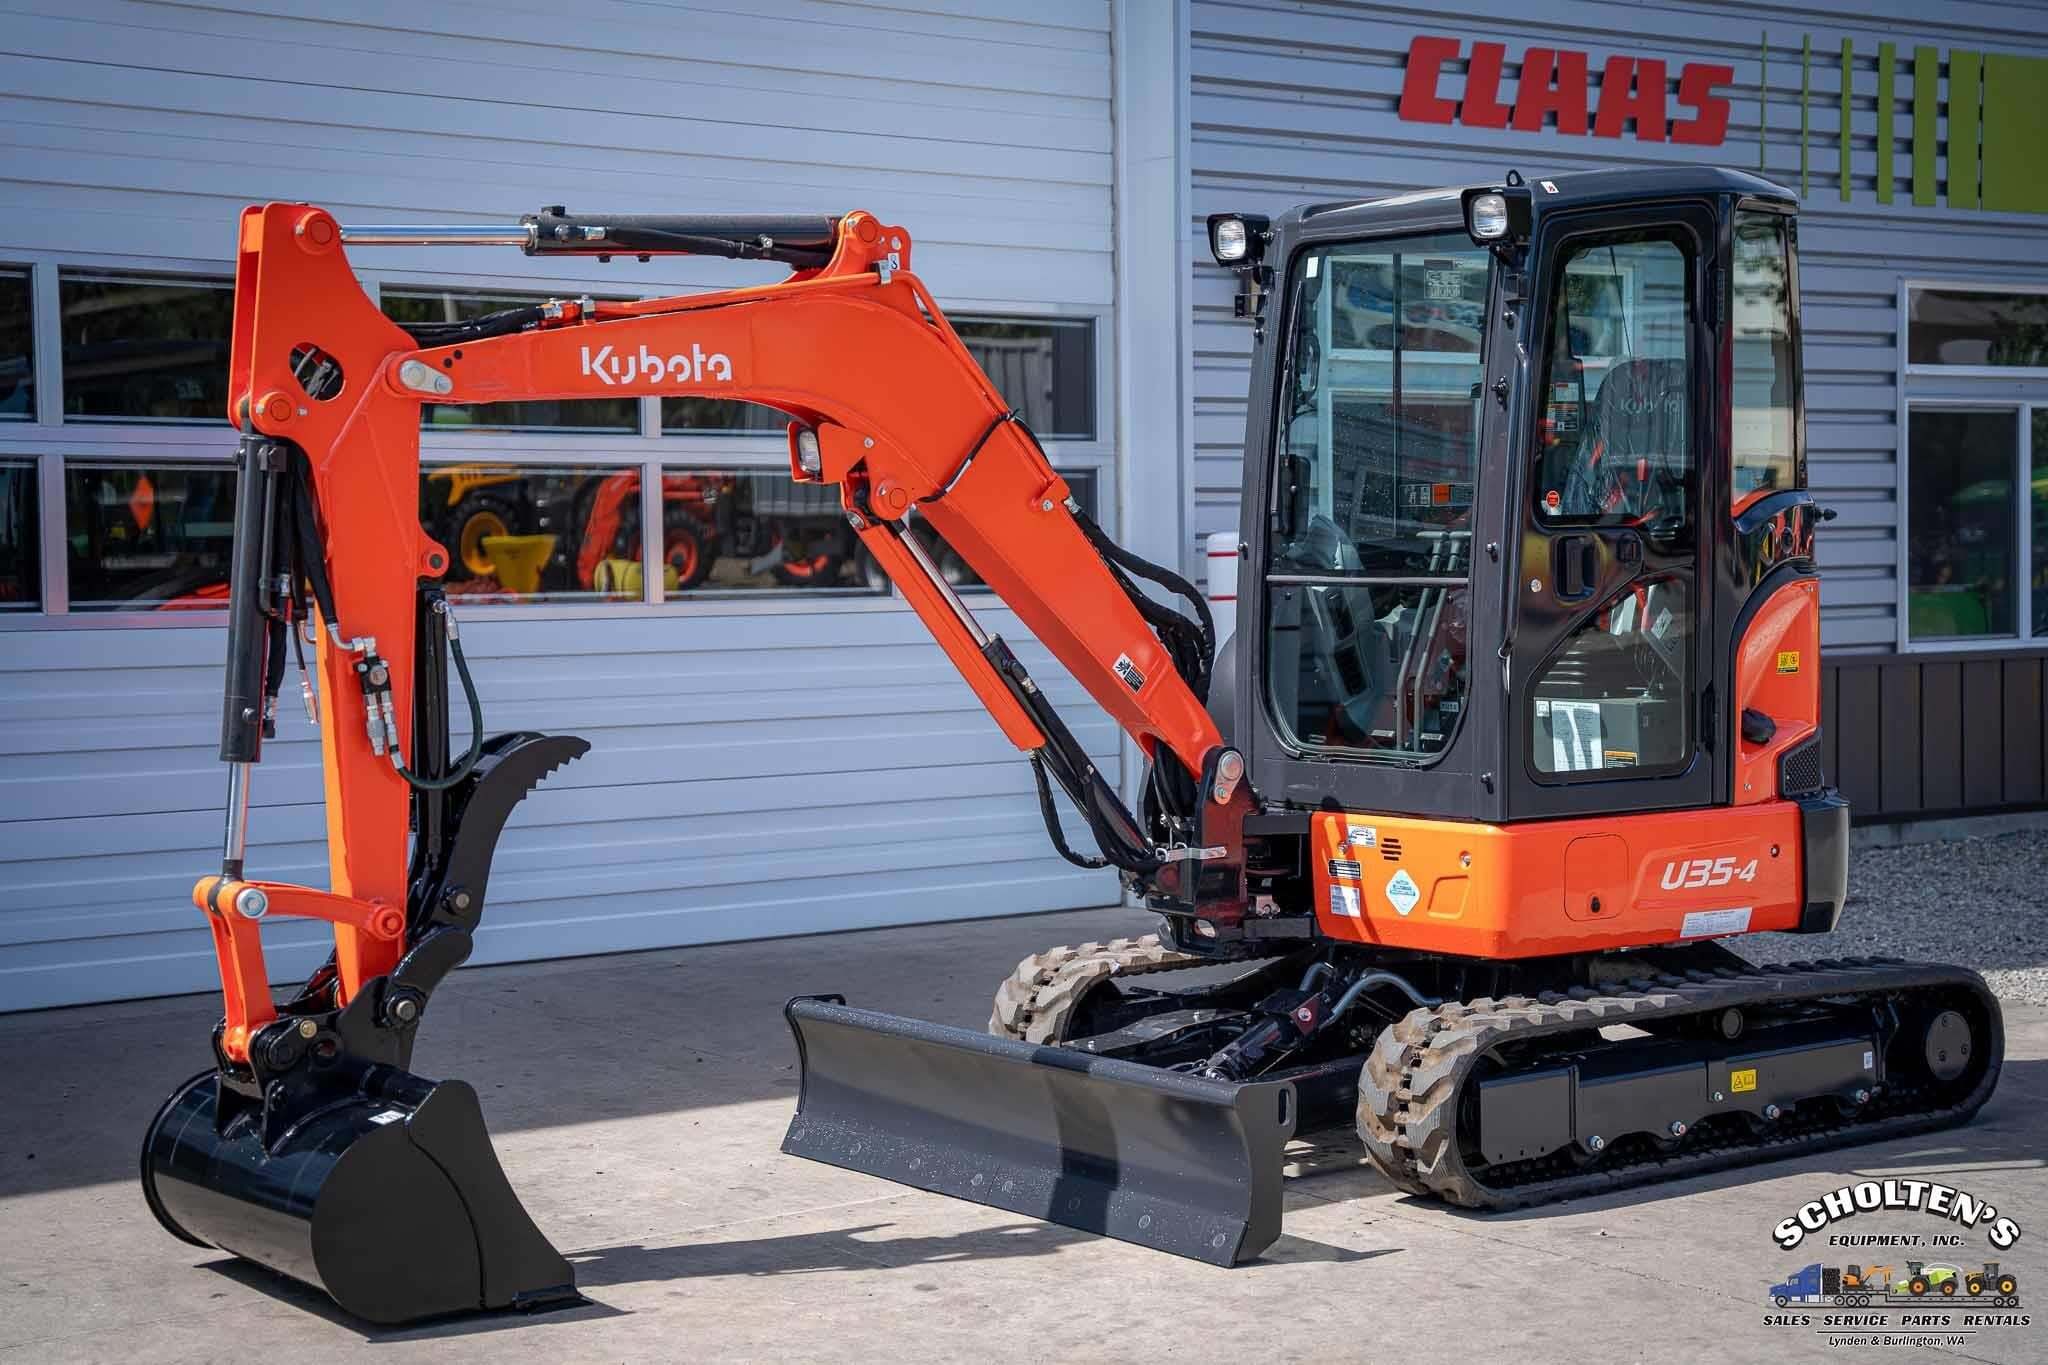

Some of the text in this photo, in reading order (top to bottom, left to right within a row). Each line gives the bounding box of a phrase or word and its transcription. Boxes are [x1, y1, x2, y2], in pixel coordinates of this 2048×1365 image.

[1398, 35, 1734, 146] CLAAS
[581, 343, 733, 385] Kubota
[1661, 857, 1758, 890] U35-4
